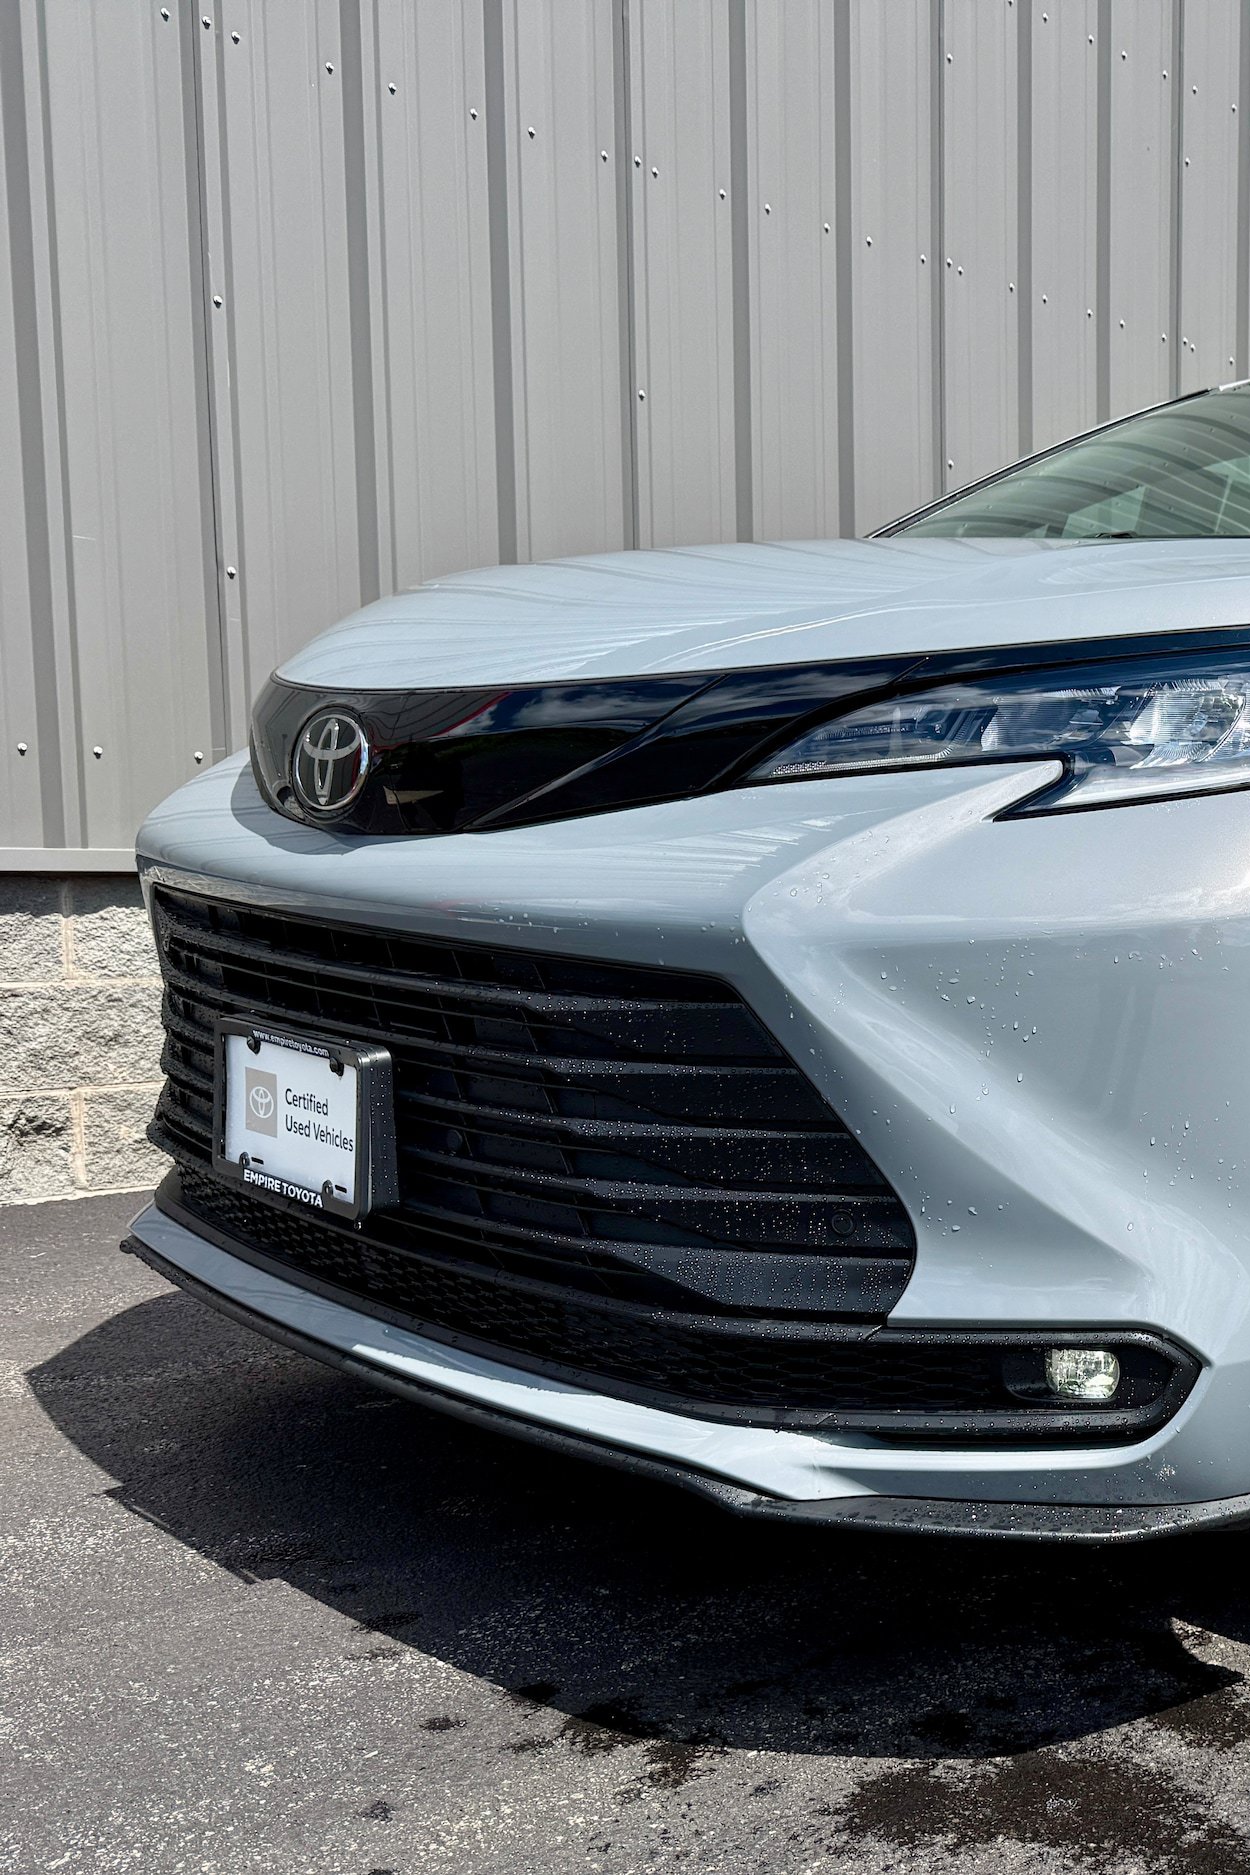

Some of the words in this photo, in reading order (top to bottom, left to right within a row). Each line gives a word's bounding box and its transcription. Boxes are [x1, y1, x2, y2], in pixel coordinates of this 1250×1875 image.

[252, 1029, 330, 1057] www.empiretoyota.com
[284, 1087, 329, 1116] Certified
[285, 1114, 311, 1138] Used
[313, 1123, 354, 1152] Vehicles
[243, 1168, 281, 1192] EMPIRE
[282, 1182, 324, 1208] TOYOTA
